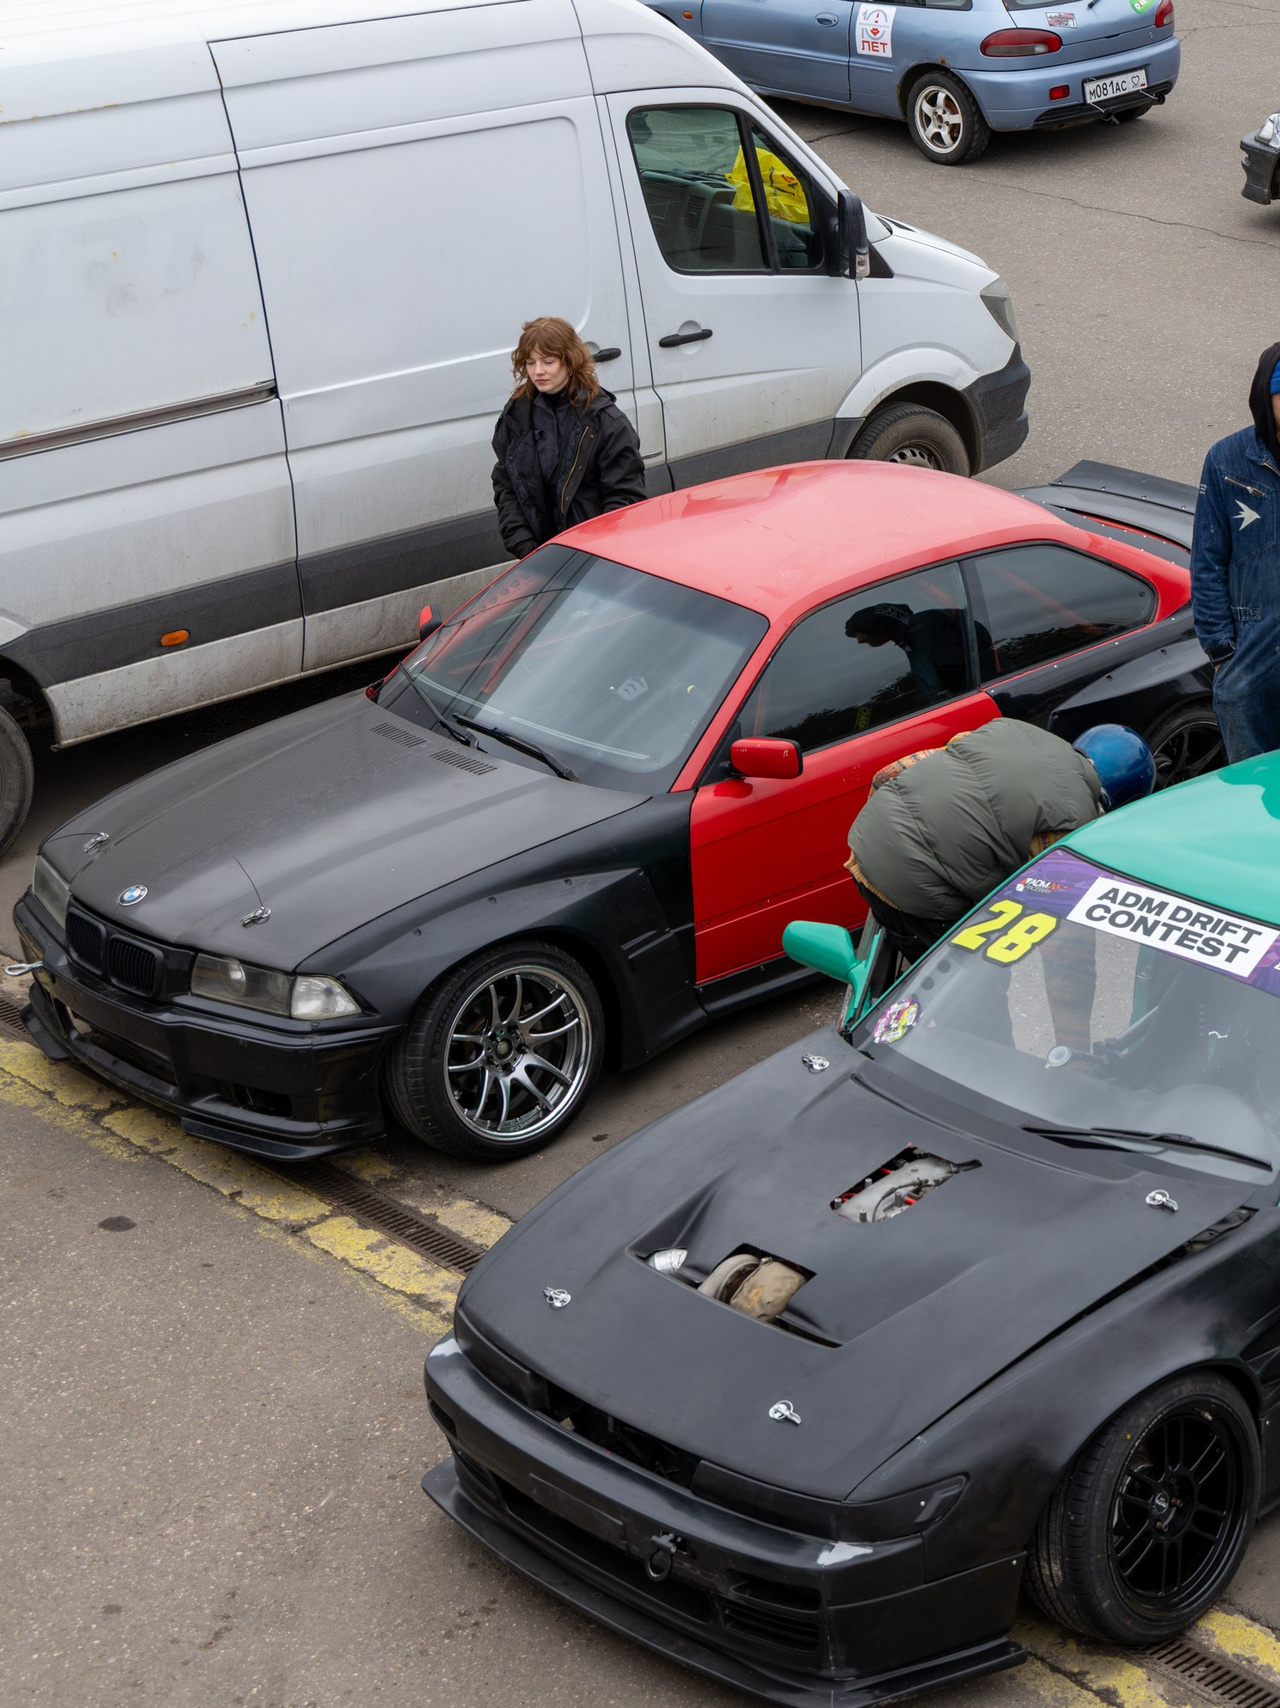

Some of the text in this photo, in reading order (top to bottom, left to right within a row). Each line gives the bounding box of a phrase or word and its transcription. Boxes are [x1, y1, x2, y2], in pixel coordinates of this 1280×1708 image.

[861, 40, 888, 53] ЛЕТ
[1028, 878, 1052, 889] ADM
[950, 899, 1058, 965] 28
[1085, 903, 1250, 964] CONTEST
[1096, 887, 1263, 945] ADM DRIFT
